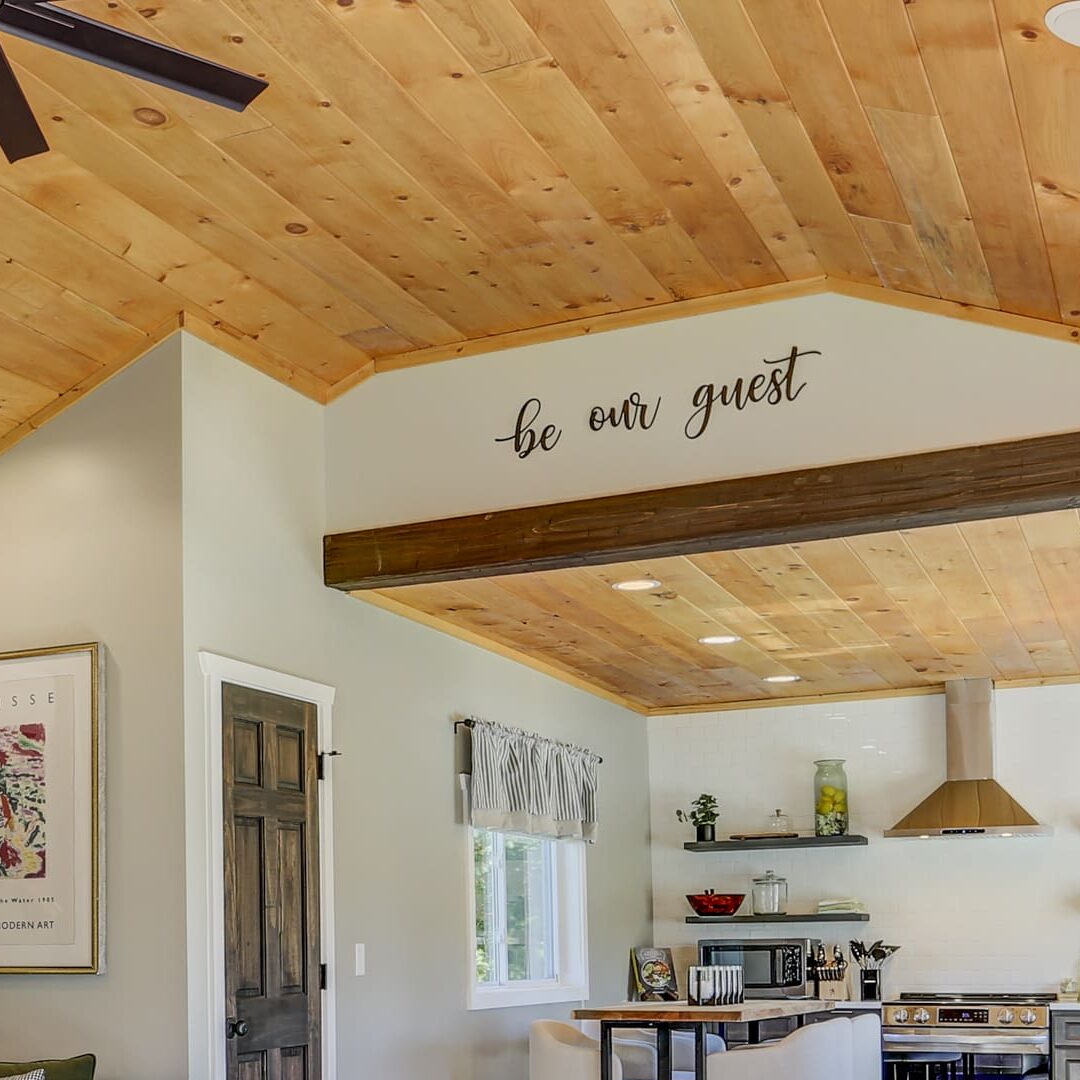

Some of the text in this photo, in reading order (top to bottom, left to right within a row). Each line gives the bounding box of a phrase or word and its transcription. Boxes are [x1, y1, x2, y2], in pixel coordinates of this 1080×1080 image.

[494, 346, 822, 459] be our guest
[36, 920, 54, 929] ART
